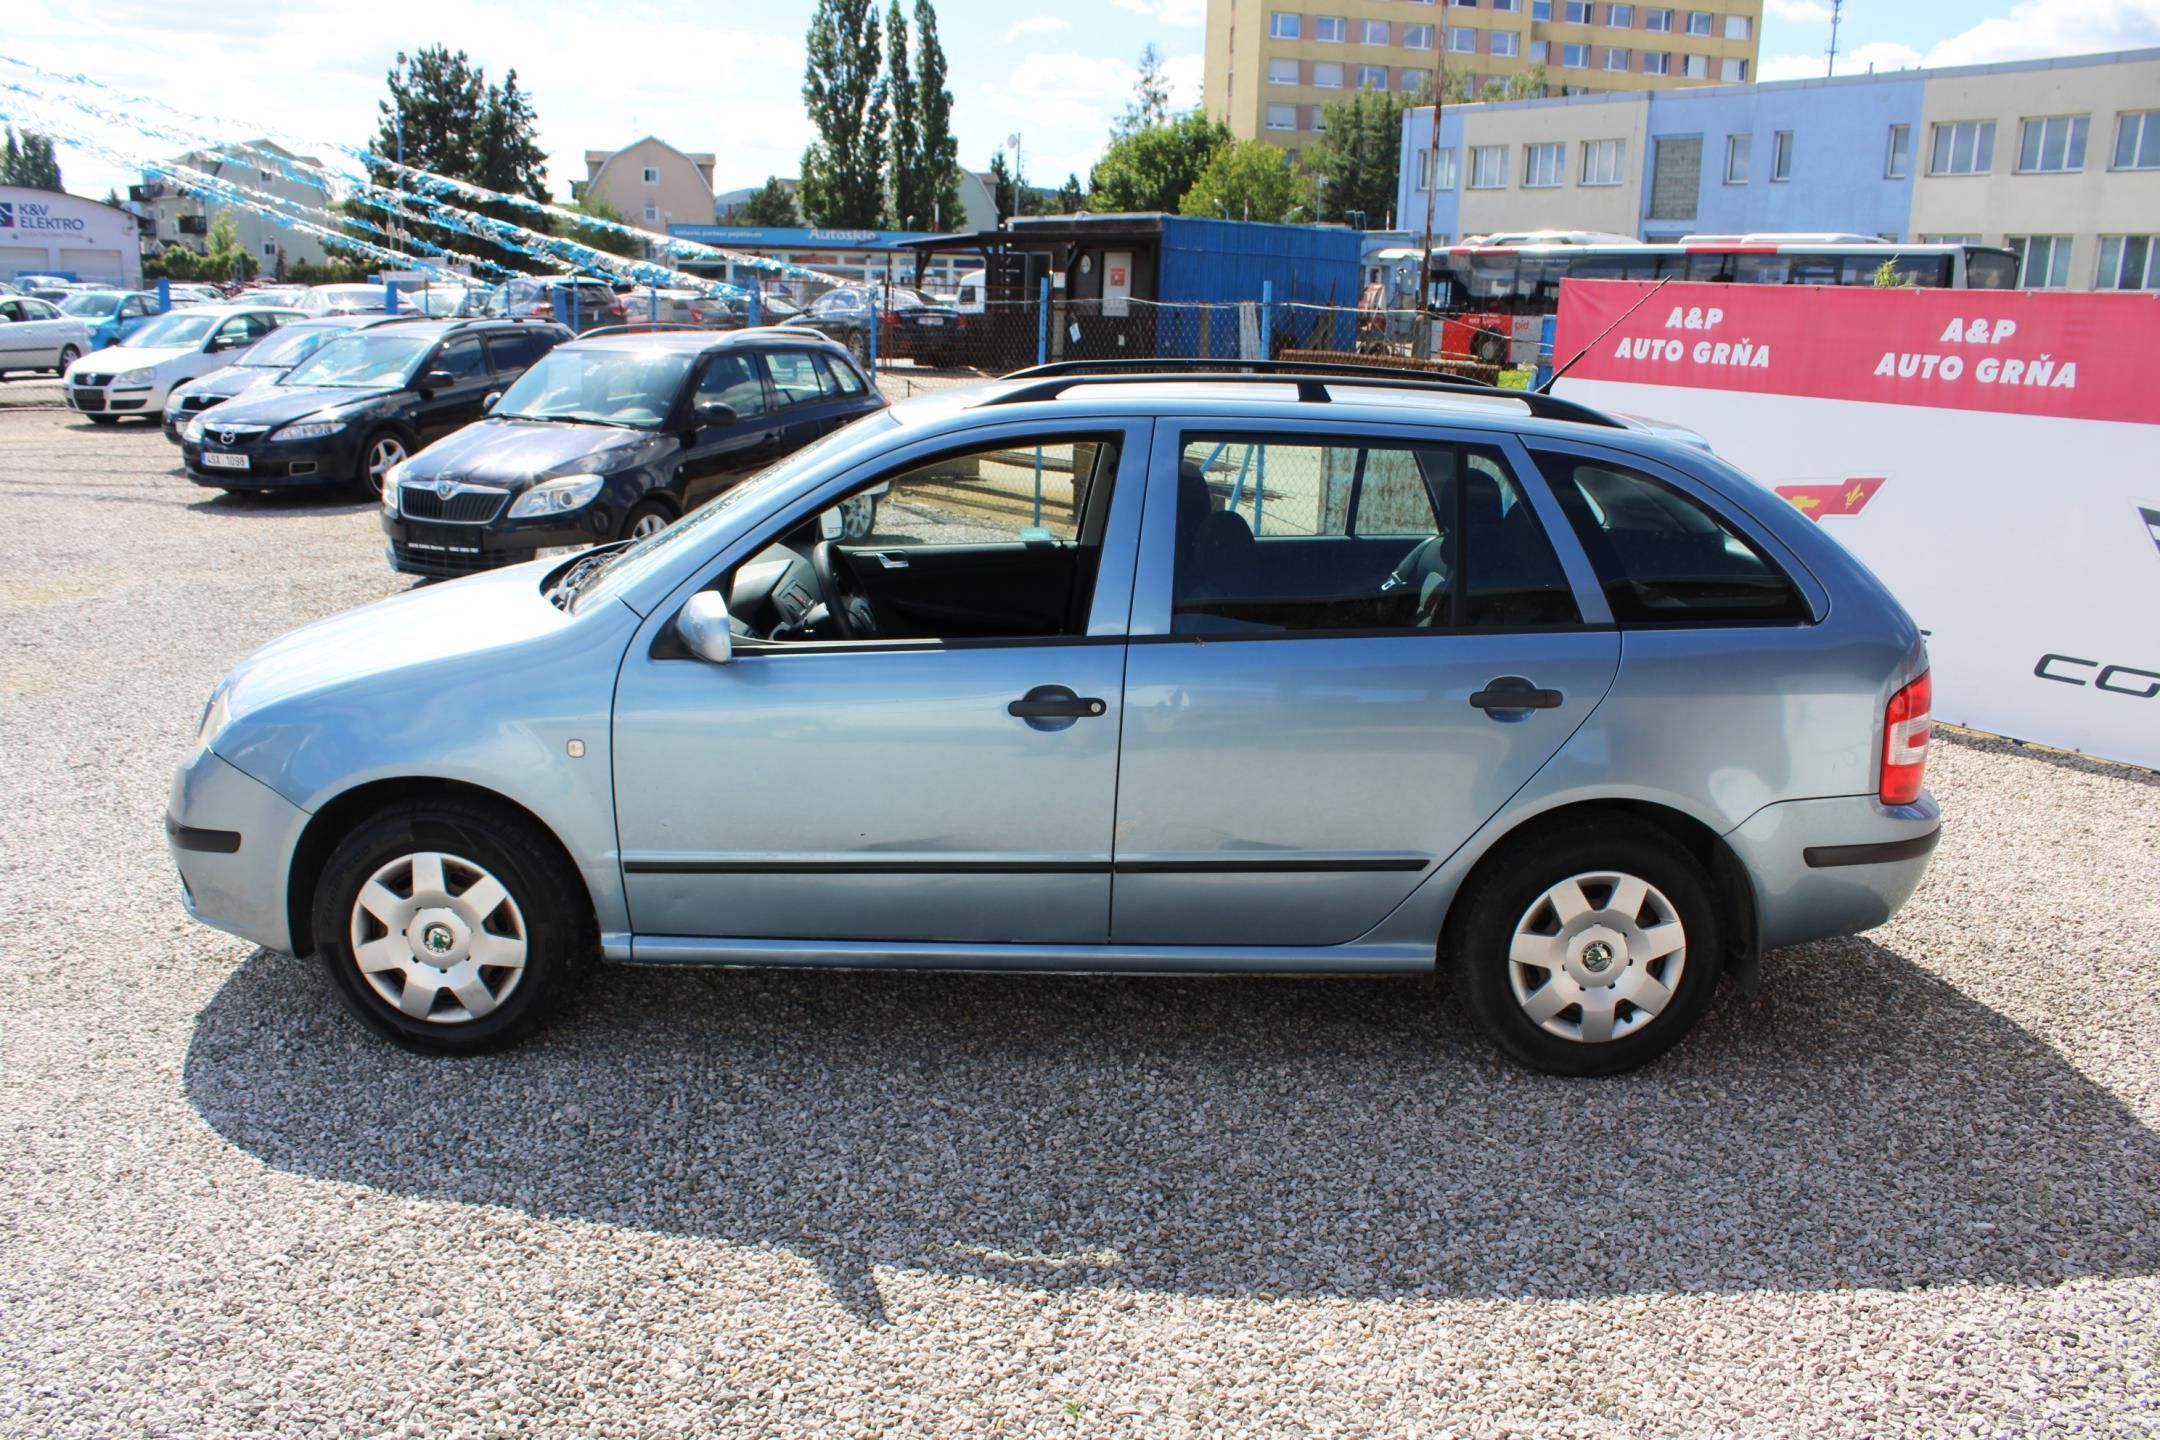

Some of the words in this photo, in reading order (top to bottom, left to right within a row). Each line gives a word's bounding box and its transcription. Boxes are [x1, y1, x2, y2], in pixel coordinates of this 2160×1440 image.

[18, 203, 48, 216] K&V
[20, 217, 85, 231] ELEKTRO
[1664, 306, 1724, 329] A&P
[1939, 317, 2017, 344] A&P
[1614, 337, 1685, 362] AUTO
[1693, 337, 1770, 368] GRŇA
[1873, 352, 1964, 381] AUTO
[1975, 353, 2076, 388] GRŇA
